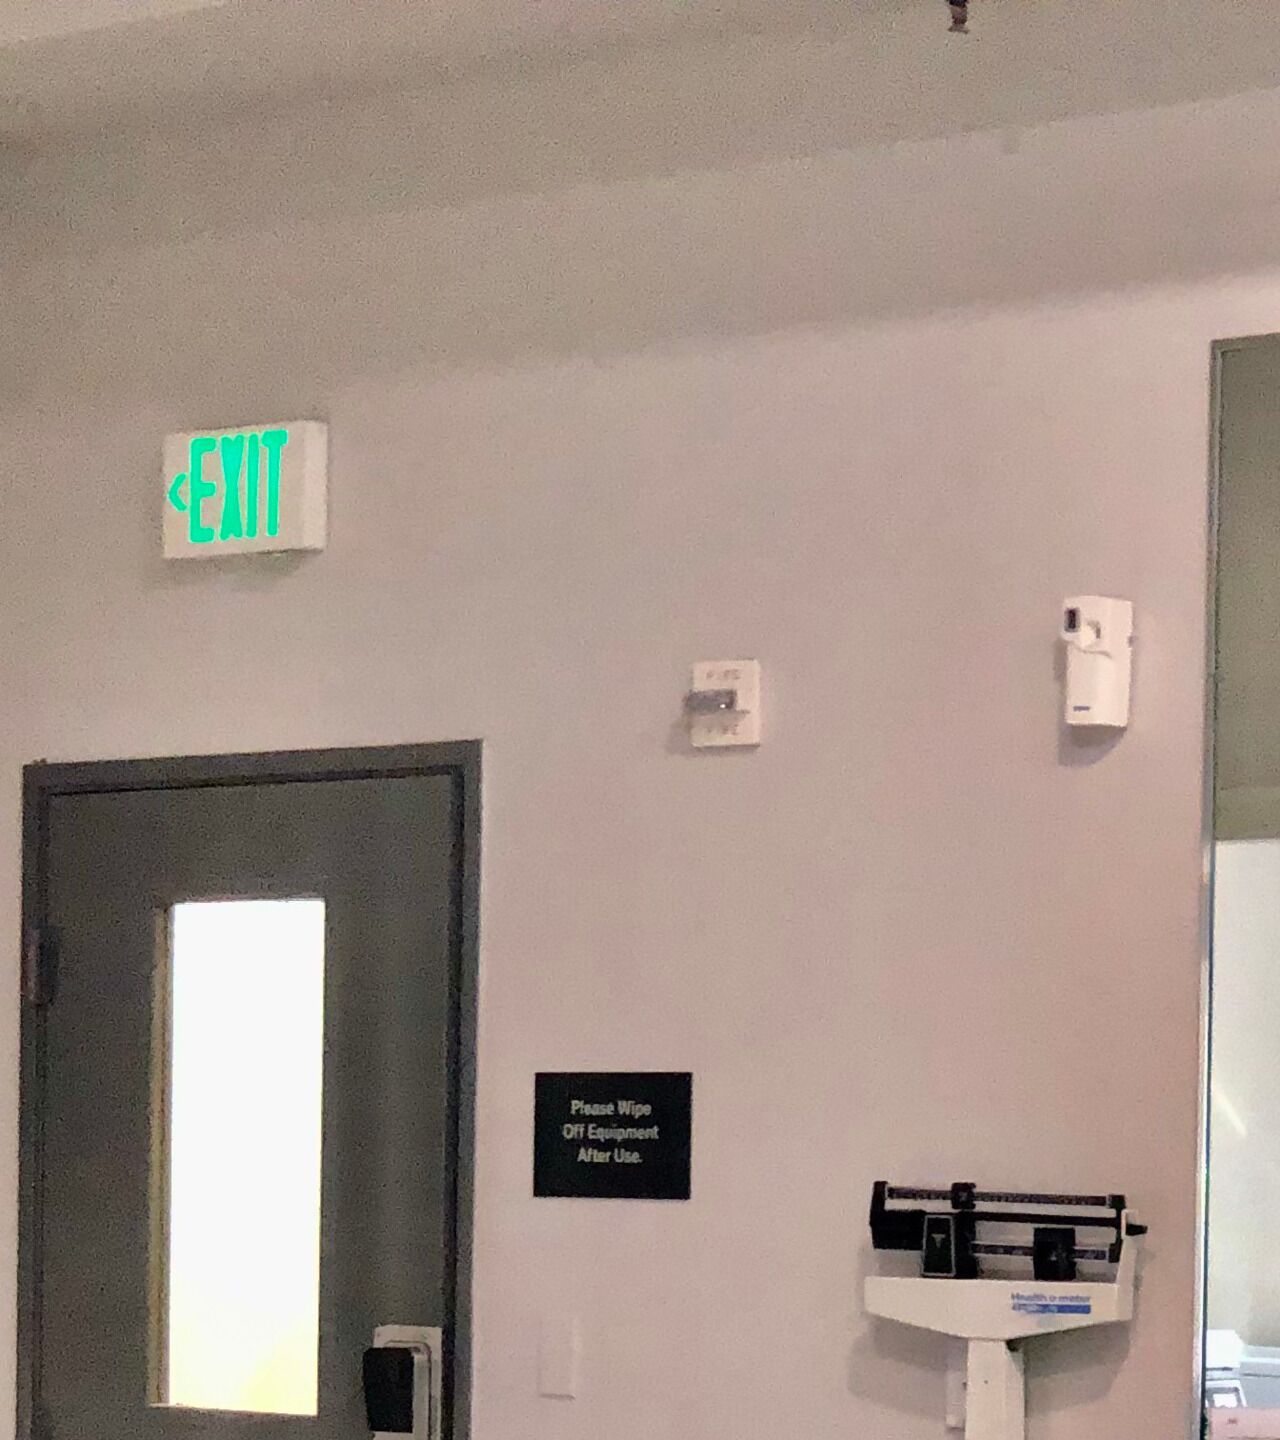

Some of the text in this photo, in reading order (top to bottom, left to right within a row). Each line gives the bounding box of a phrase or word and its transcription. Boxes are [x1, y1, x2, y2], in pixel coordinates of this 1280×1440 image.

[189, 429, 288, 543] EXIT
[570, 1099, 652, 1119] Please Wipe
[562, 1123, 660, 1143] Off Equipment
[577, 1147, 612, 1163] After
